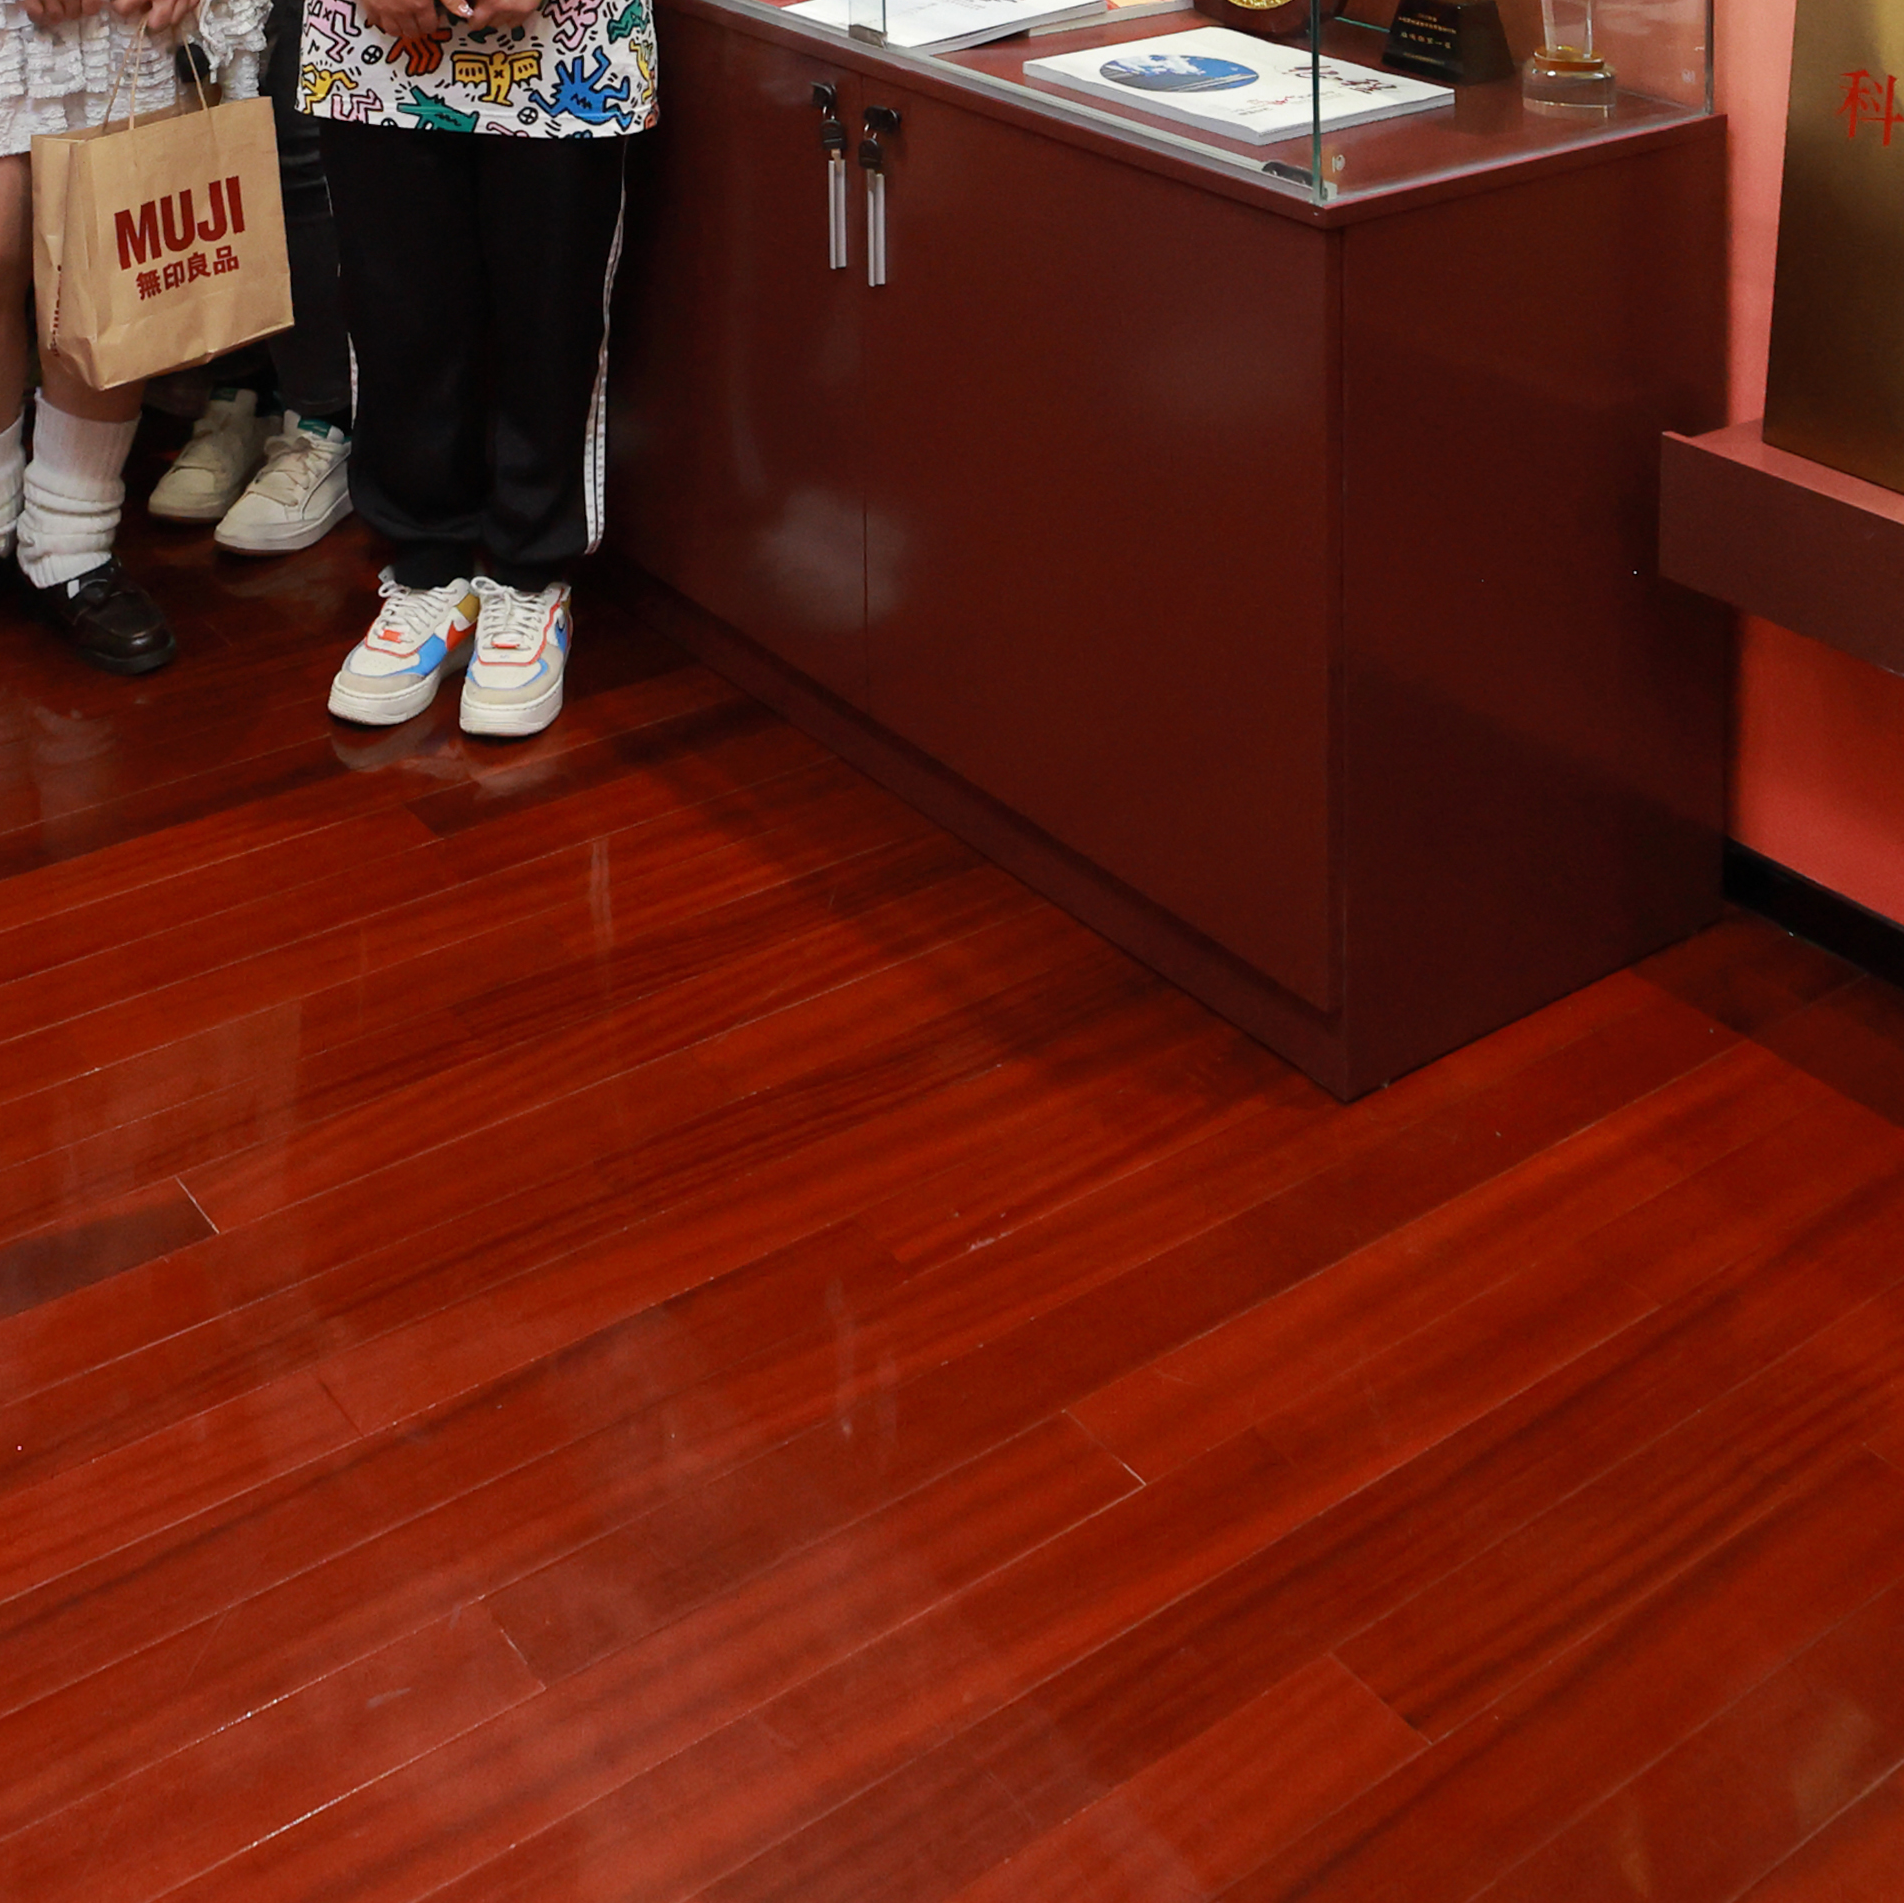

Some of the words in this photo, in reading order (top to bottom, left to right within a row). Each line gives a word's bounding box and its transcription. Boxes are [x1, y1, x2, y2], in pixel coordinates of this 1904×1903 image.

[114, 174, 247, 272] MUJI
[135, 245, 242, 304] 無印良品
